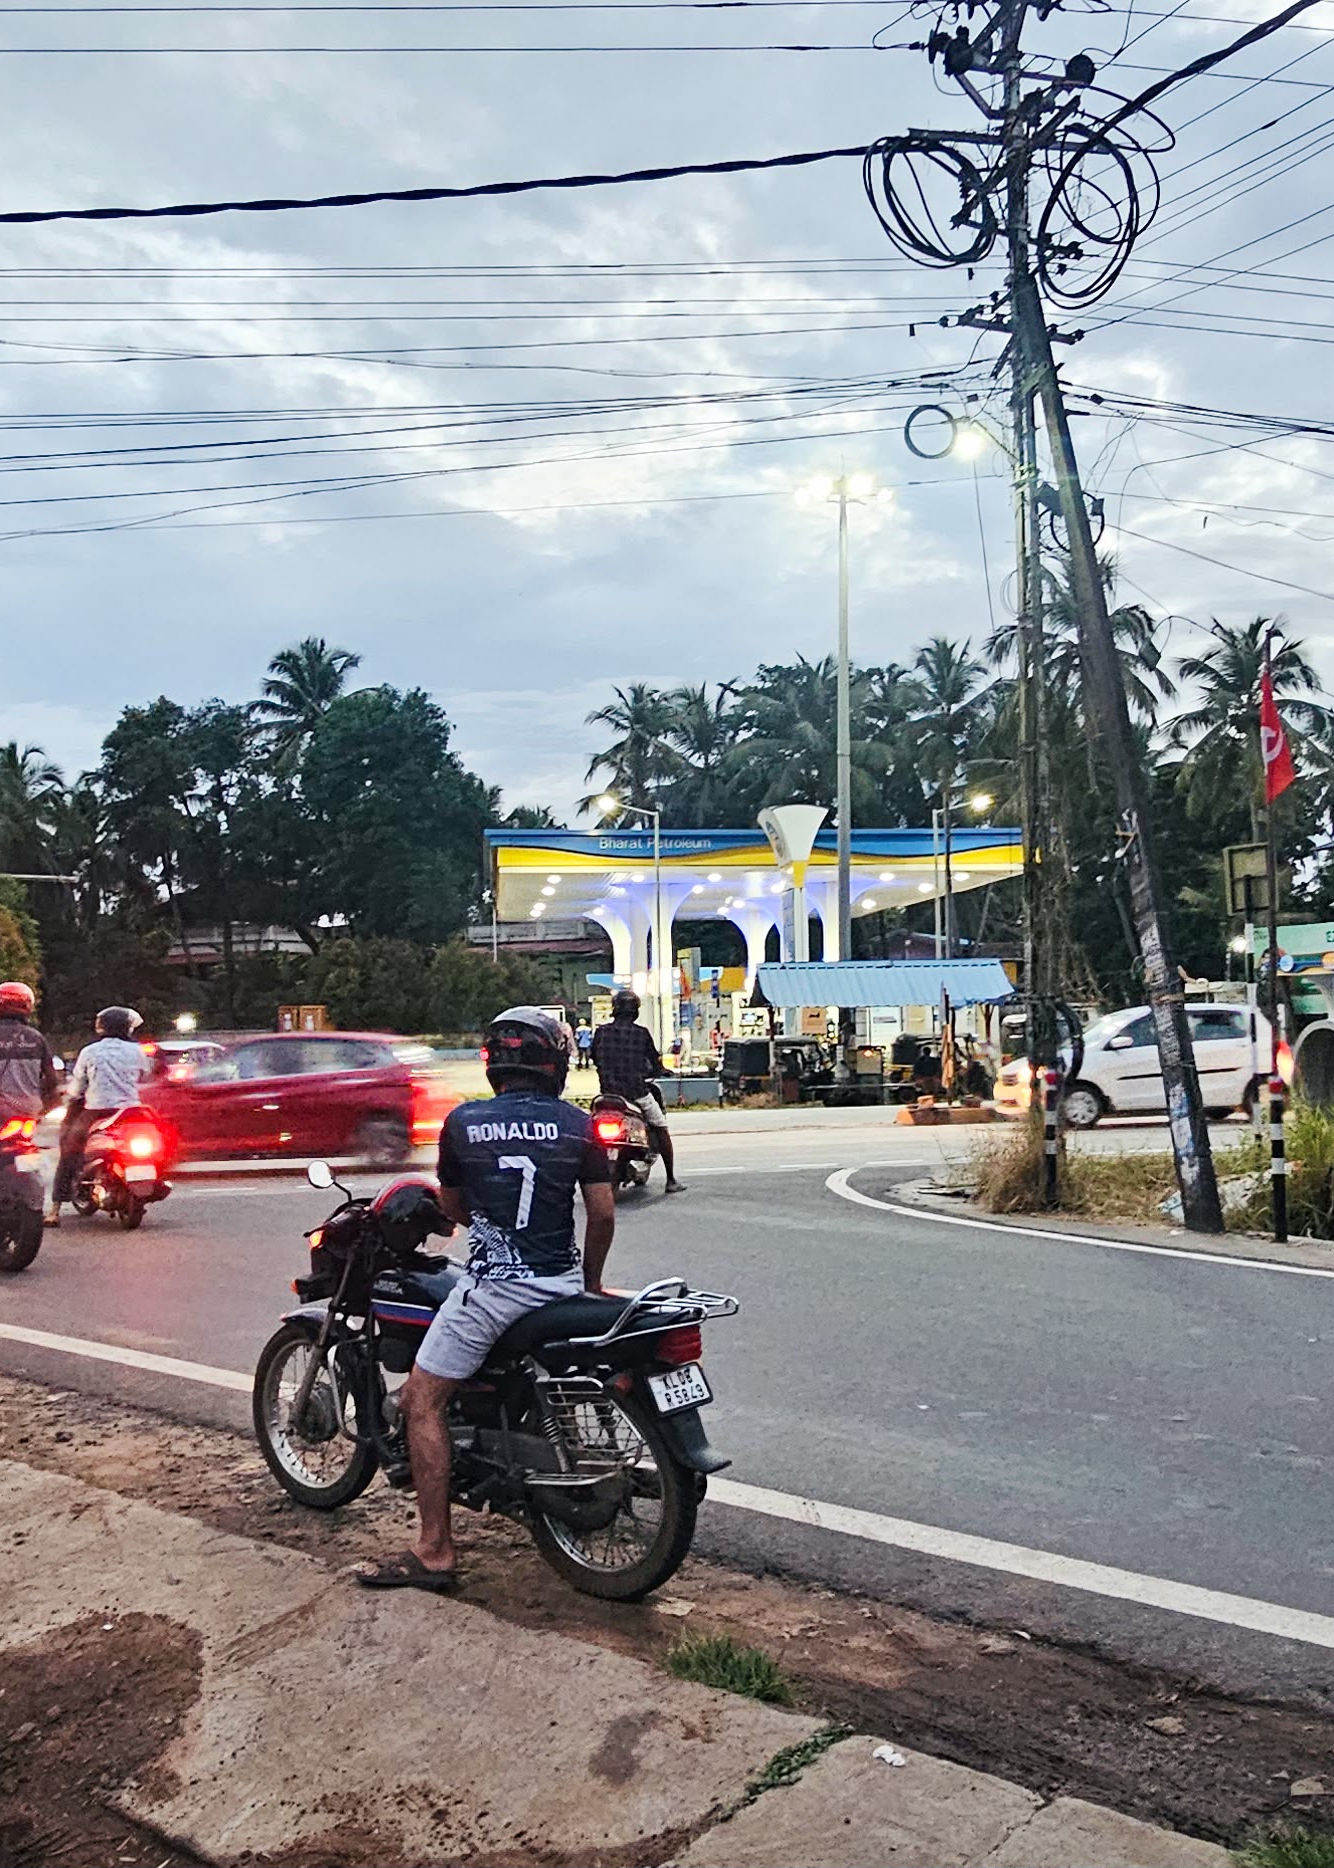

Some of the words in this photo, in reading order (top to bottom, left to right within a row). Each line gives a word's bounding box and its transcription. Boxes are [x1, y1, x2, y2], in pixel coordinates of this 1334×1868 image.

[599, 837, 642, 849] Bharat
[647, 837, 712, 849] Petroleum
[467, 1122, 559, 1143] RONALDO
[498, 1155, 537, 1230] 7
[662, 1367, 693, 1391] KL08
